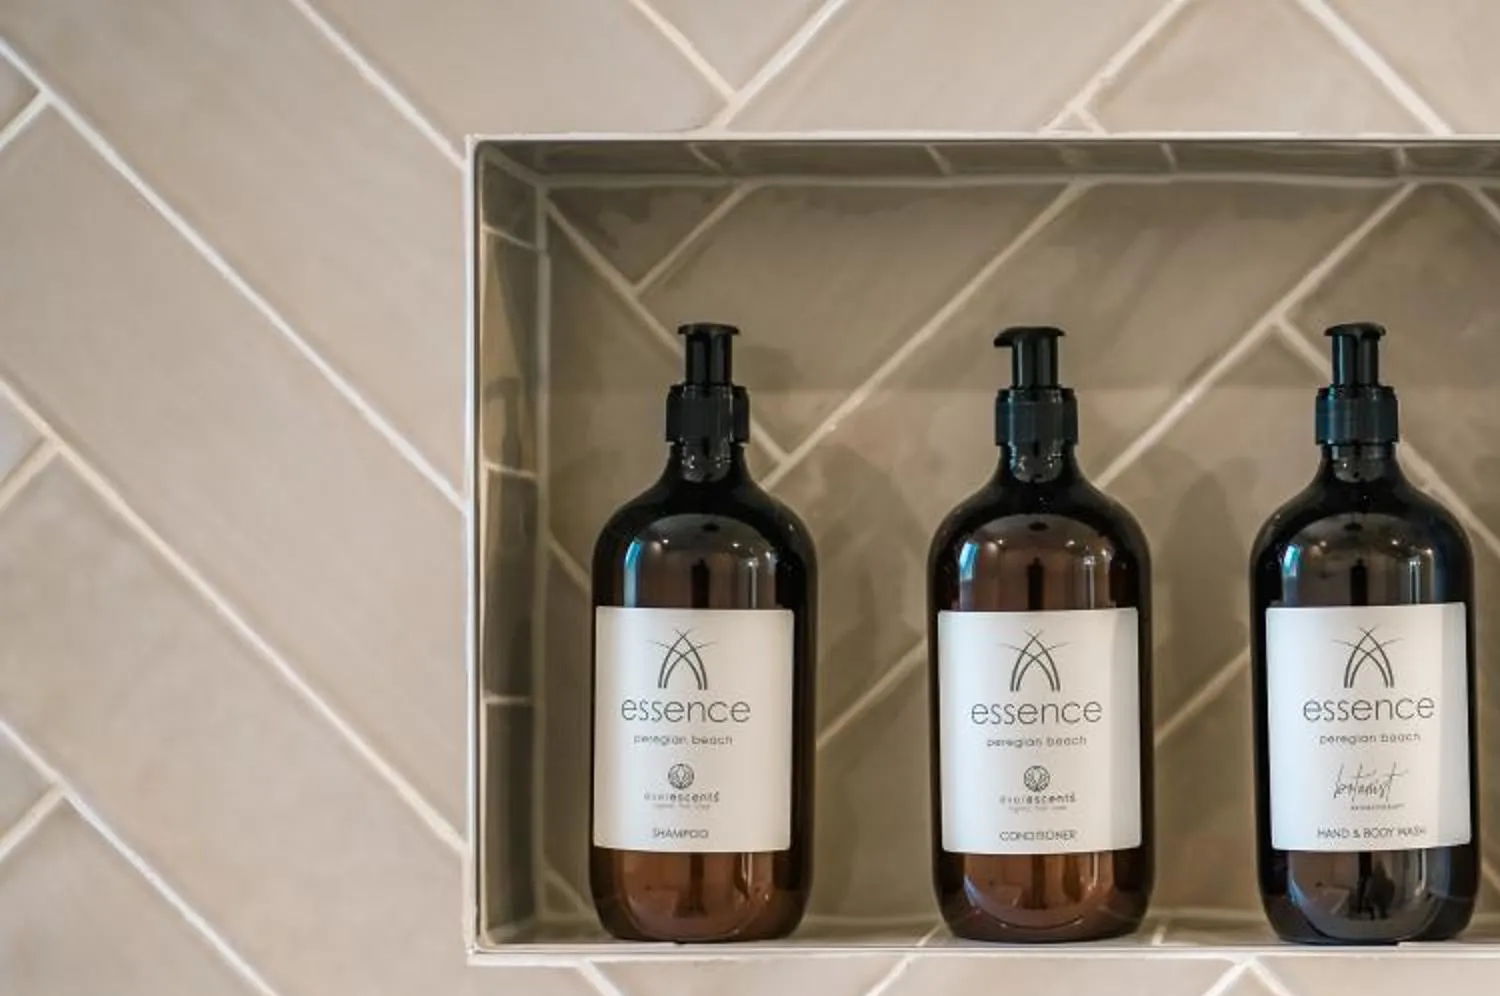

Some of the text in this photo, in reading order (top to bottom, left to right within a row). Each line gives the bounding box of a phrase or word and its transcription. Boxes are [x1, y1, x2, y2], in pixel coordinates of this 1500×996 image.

[621, 699, 751, 723] essence
[971, 701, 1103, 725] essence
[1303, 697, 1435, 722] essence
[633, 734, 733, 746] peregian beach
[987, 736, 1087, 748] peregian beach
[1319, 733, 1421, 745] peregian beach
[652, 828, 709, 839] SHAMPOO
[999, 830, 1077, 841] CONDITIONER
[1317, 824, 1427, 840] HAND & BODY WASH
